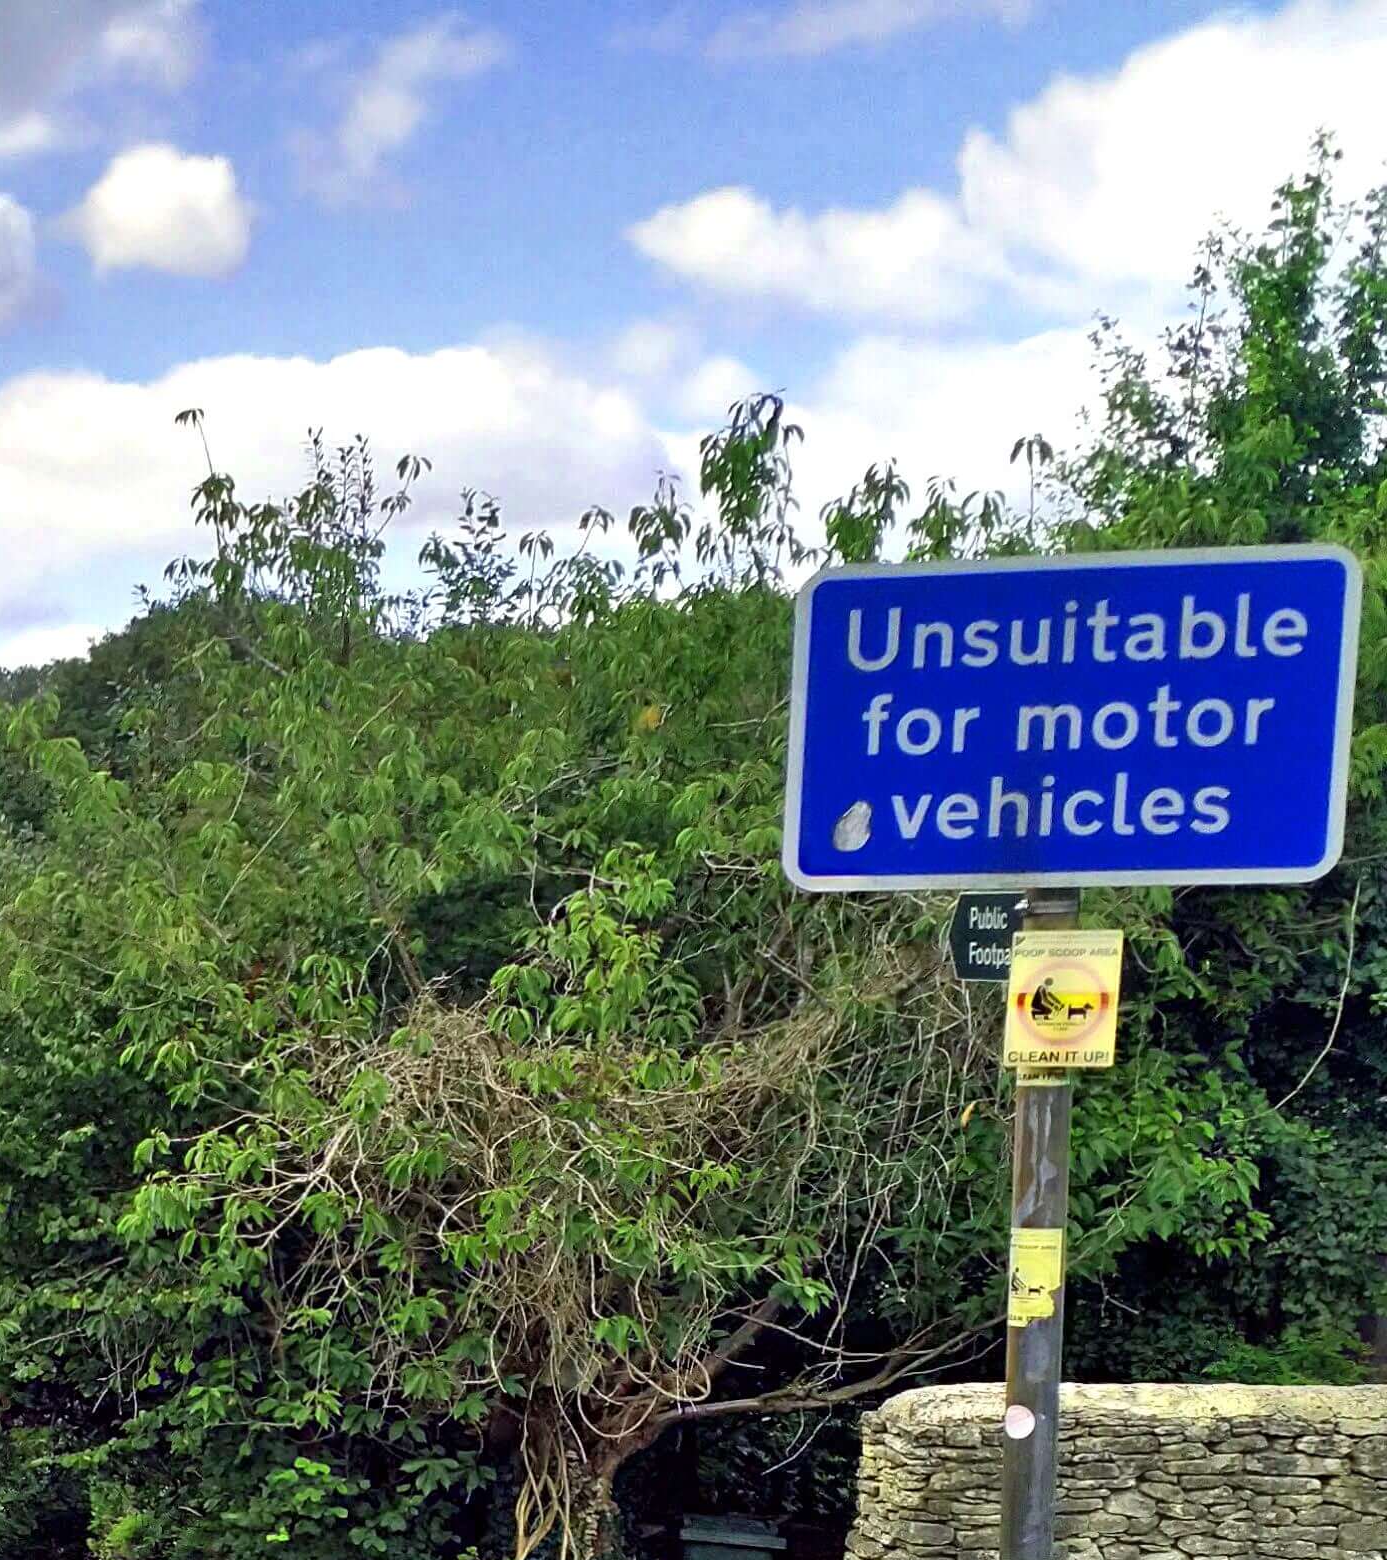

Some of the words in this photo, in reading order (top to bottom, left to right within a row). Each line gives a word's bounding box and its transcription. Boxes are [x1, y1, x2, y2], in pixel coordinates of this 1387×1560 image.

[847, 592, 1309, 673] Unsuitable
[862, 692, 981, 756] for
[1016, 684, 1276, 752] motor
[891, 772, 1232, 840] vehicles
[969, 905, 1008, 930] Public
[968, 941, 1012, 969] Footpa
[1014, 948, 1045, 958] POOP
[1048, 947, 1087, 957] SCOOP
[1089, 947, 1120, 957] AREA
[1007, 1050, 1060, 1063] CLEAN
[1065, 1050, 1079, 1063] IT
[1083, 1050, 1110, 1063] UP!
